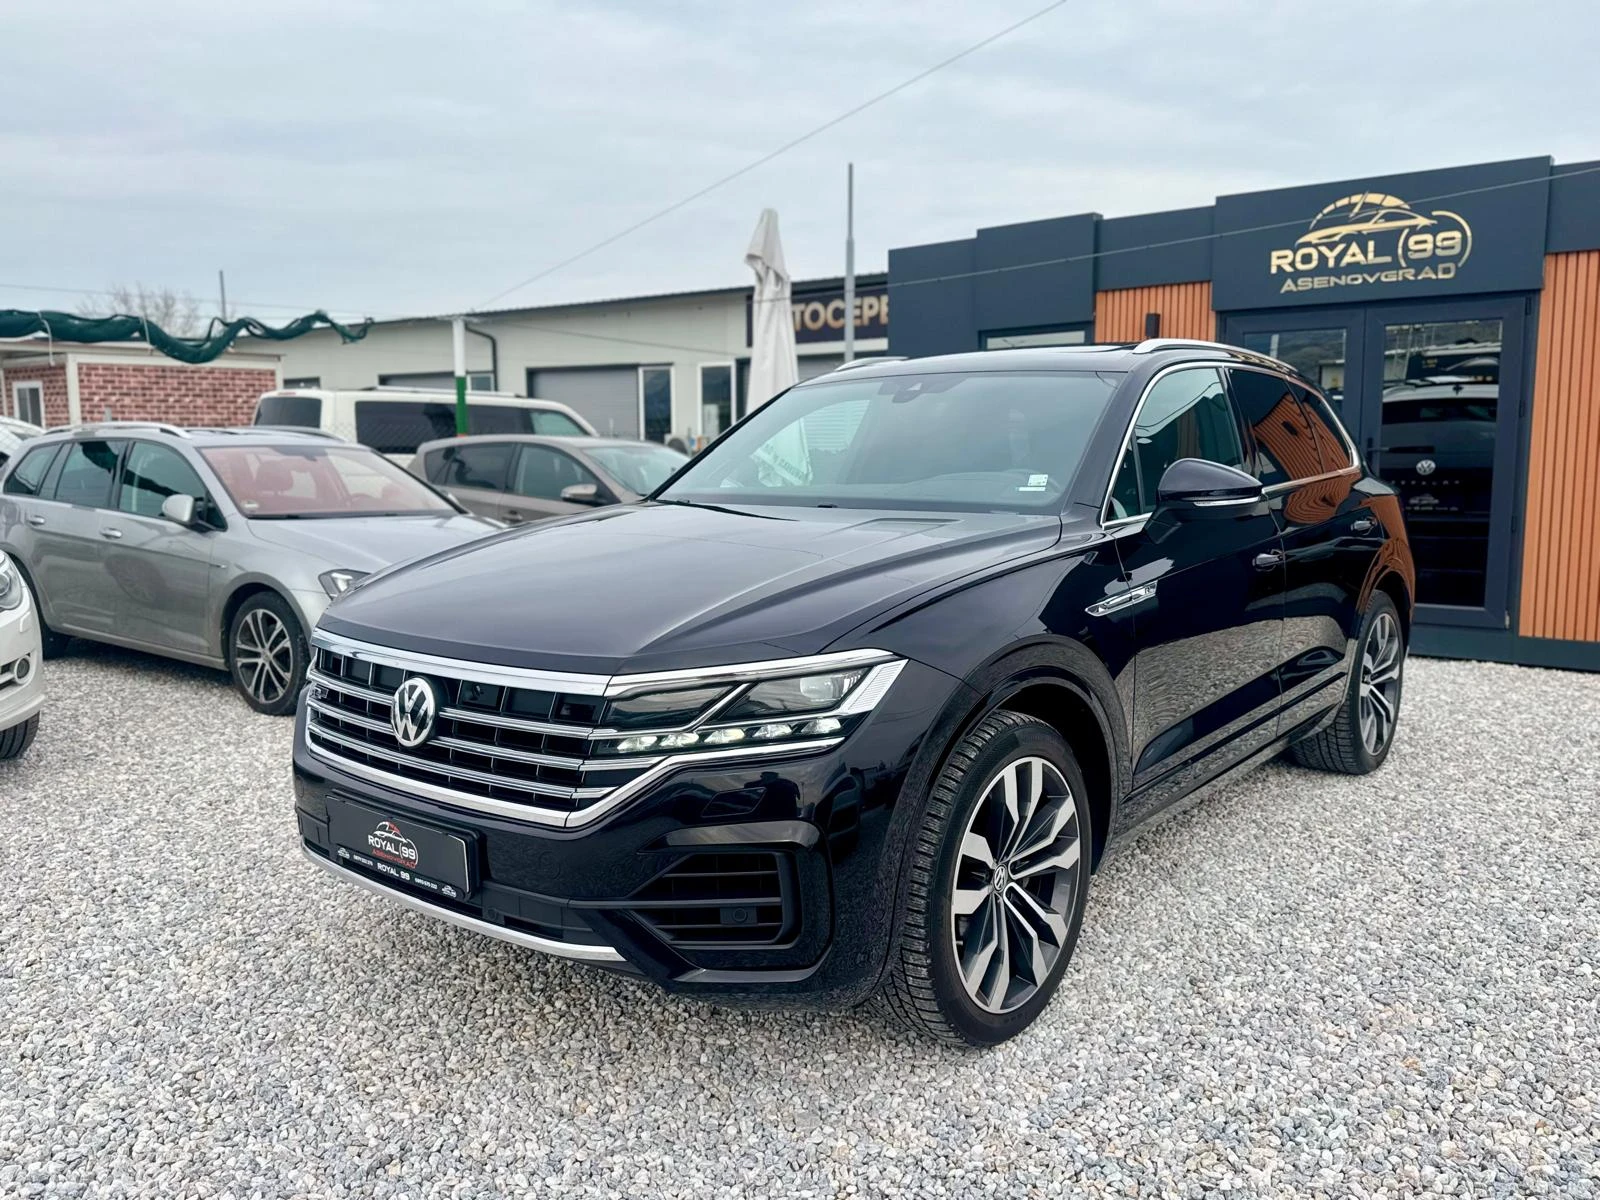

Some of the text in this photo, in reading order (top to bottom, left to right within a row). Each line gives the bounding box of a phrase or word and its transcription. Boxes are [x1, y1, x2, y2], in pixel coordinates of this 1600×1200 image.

[1270, 240, 1392, 274] ROYAL
[1280, 262, 1456, 294] ASENOVGRAD
[392, 677, 436, 747] VW
[368, 834, 399, 855] ROYAL
[377, 862, 410, 881] ROYAL 99
